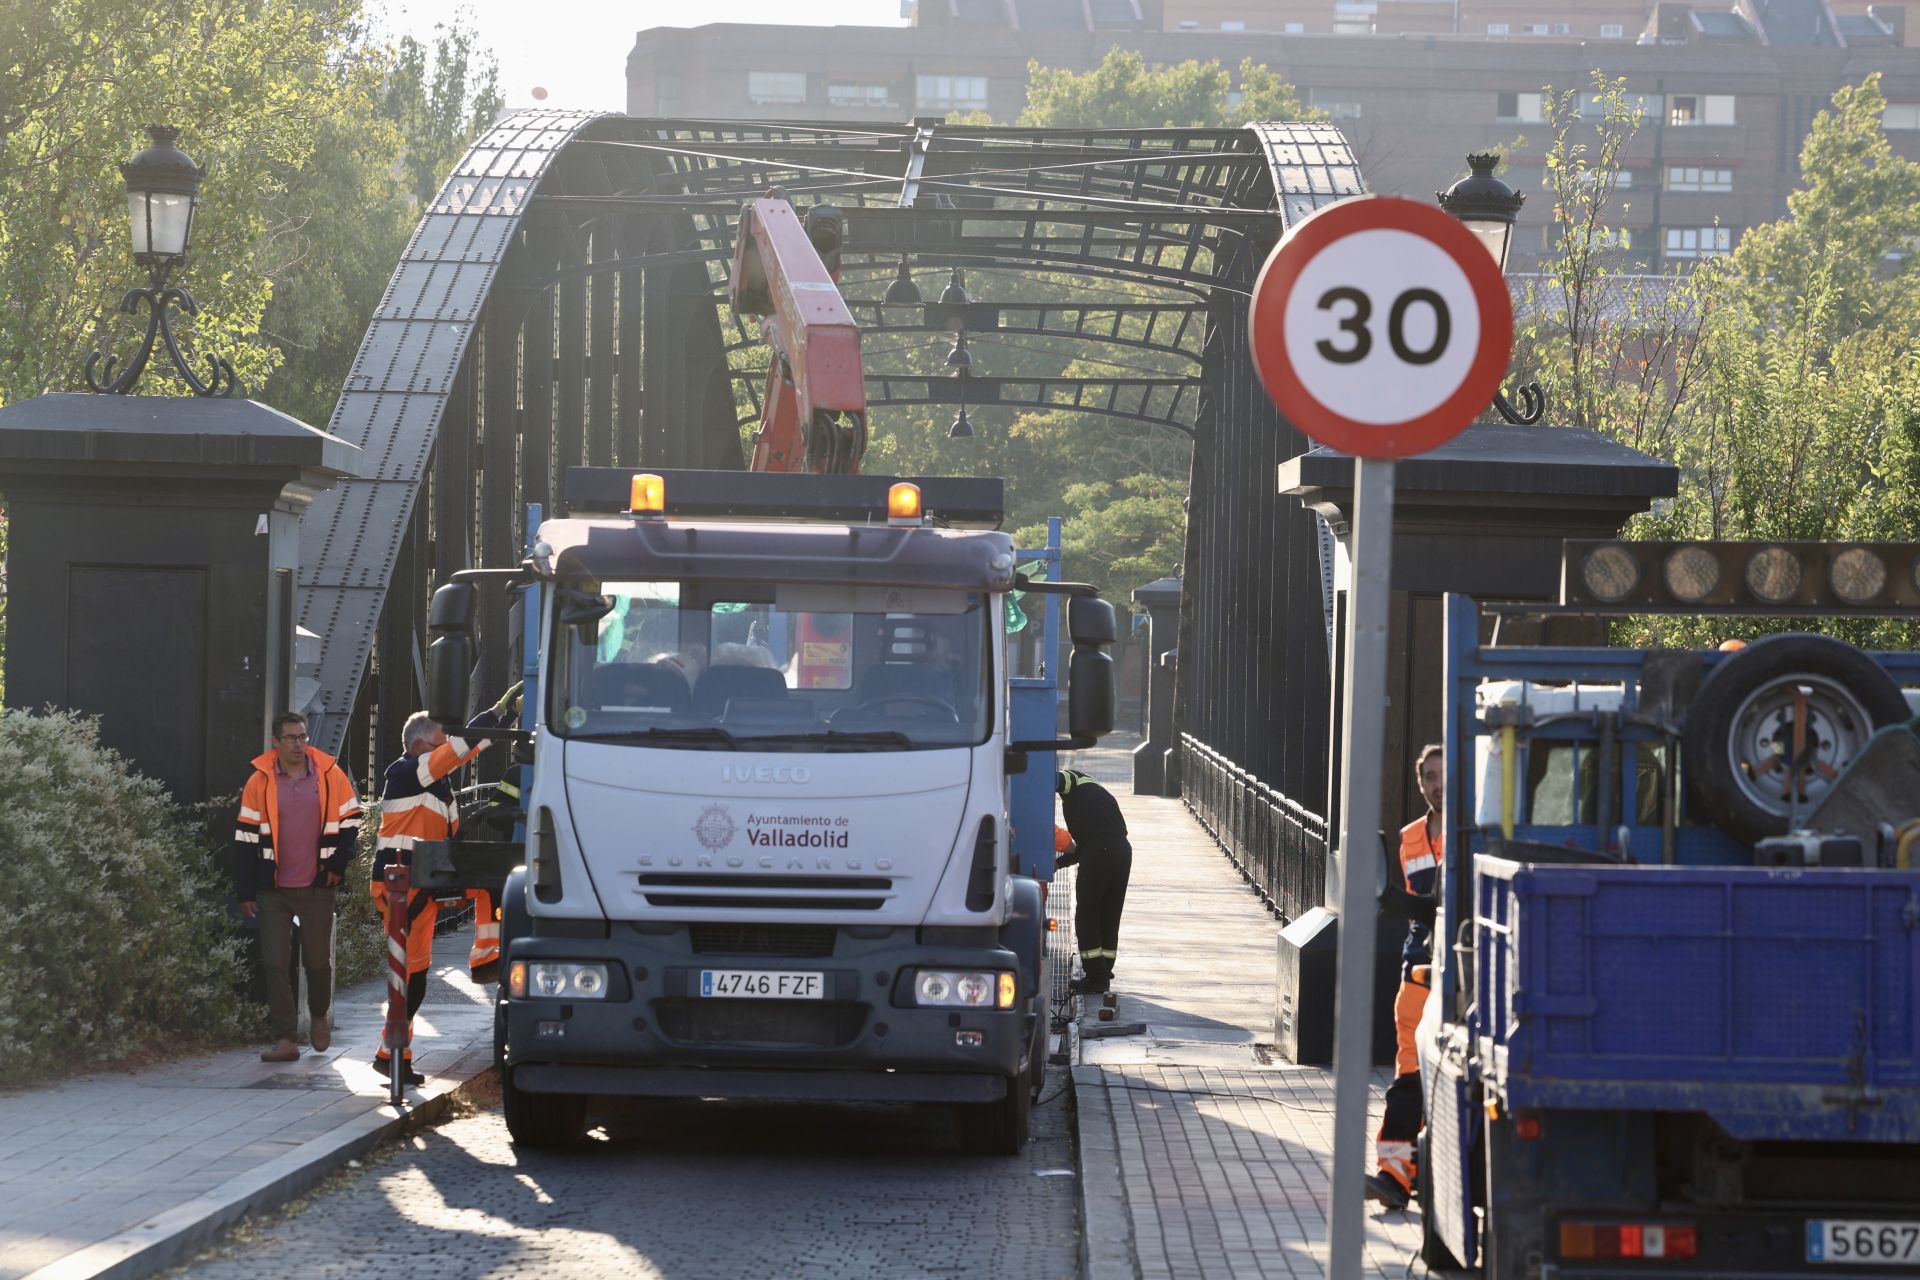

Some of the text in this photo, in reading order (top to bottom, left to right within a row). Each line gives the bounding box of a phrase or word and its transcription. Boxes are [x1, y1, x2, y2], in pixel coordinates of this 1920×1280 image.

[1316, 286, 1451, 365] 30
[721, 764, 811, 784] IVECO
[747, 814, 849, 827] Ayuntamiento de
[747, 829, 848, 848] Valladolid
[638, 853, 893, 871] EUROCARGO
[717, 975, 818, 995] 4746 FZF
[1831, 1226, 1919, 1259] 5667
